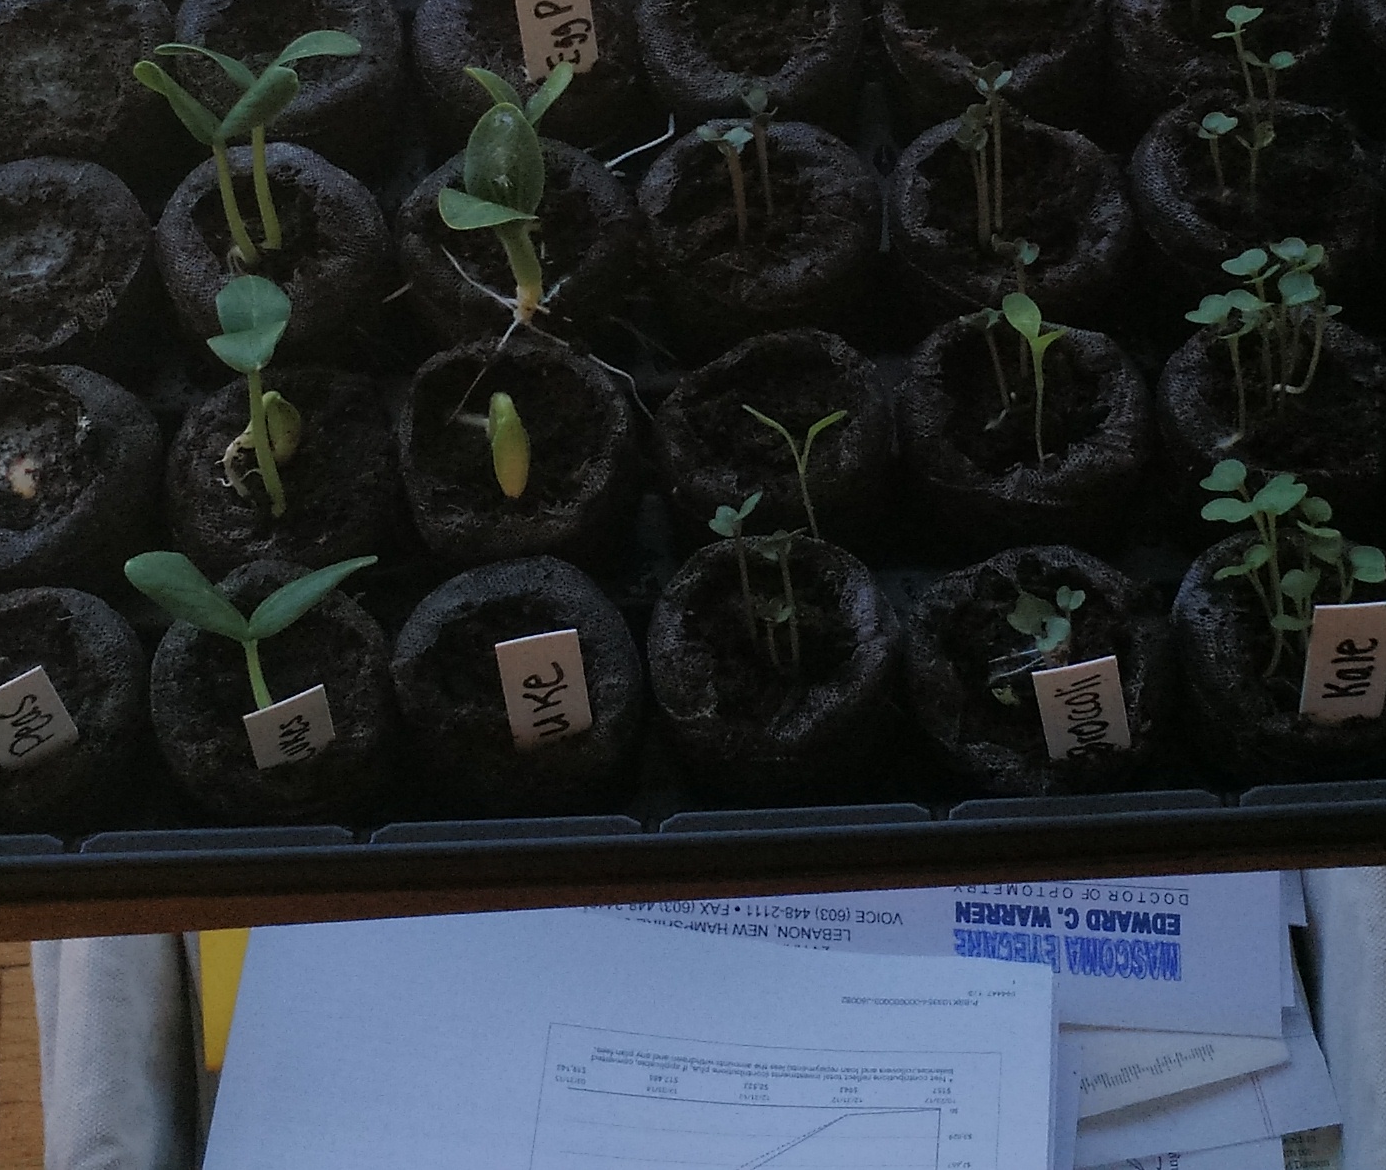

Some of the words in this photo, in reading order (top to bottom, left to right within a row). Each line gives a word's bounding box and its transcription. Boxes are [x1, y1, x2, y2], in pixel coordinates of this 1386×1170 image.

[1320, 636, 1379, 699] Kale
[1081, 888, 1101, 901] OF
[1108, 889, 1189, 906] DOCTOR
[699, 902, 730, 916] FAX
[745, 904, 810, 920] 448-2111
[815, 906, 851, 922] (603)
[854, 909, 903, 926] VOICE
[954, 901, 1052, 929] WARREN
[1057, 906, 1080, 930] C.
[732, 922, 768, 937] NEW
[1085, 908, 1182, 936] EDWARD
[773, 923, 851, 942] LEBANON,
[953, 928, 1061, 973] EYECARE
[1064, 935, 1182, 982] MASCOMA
